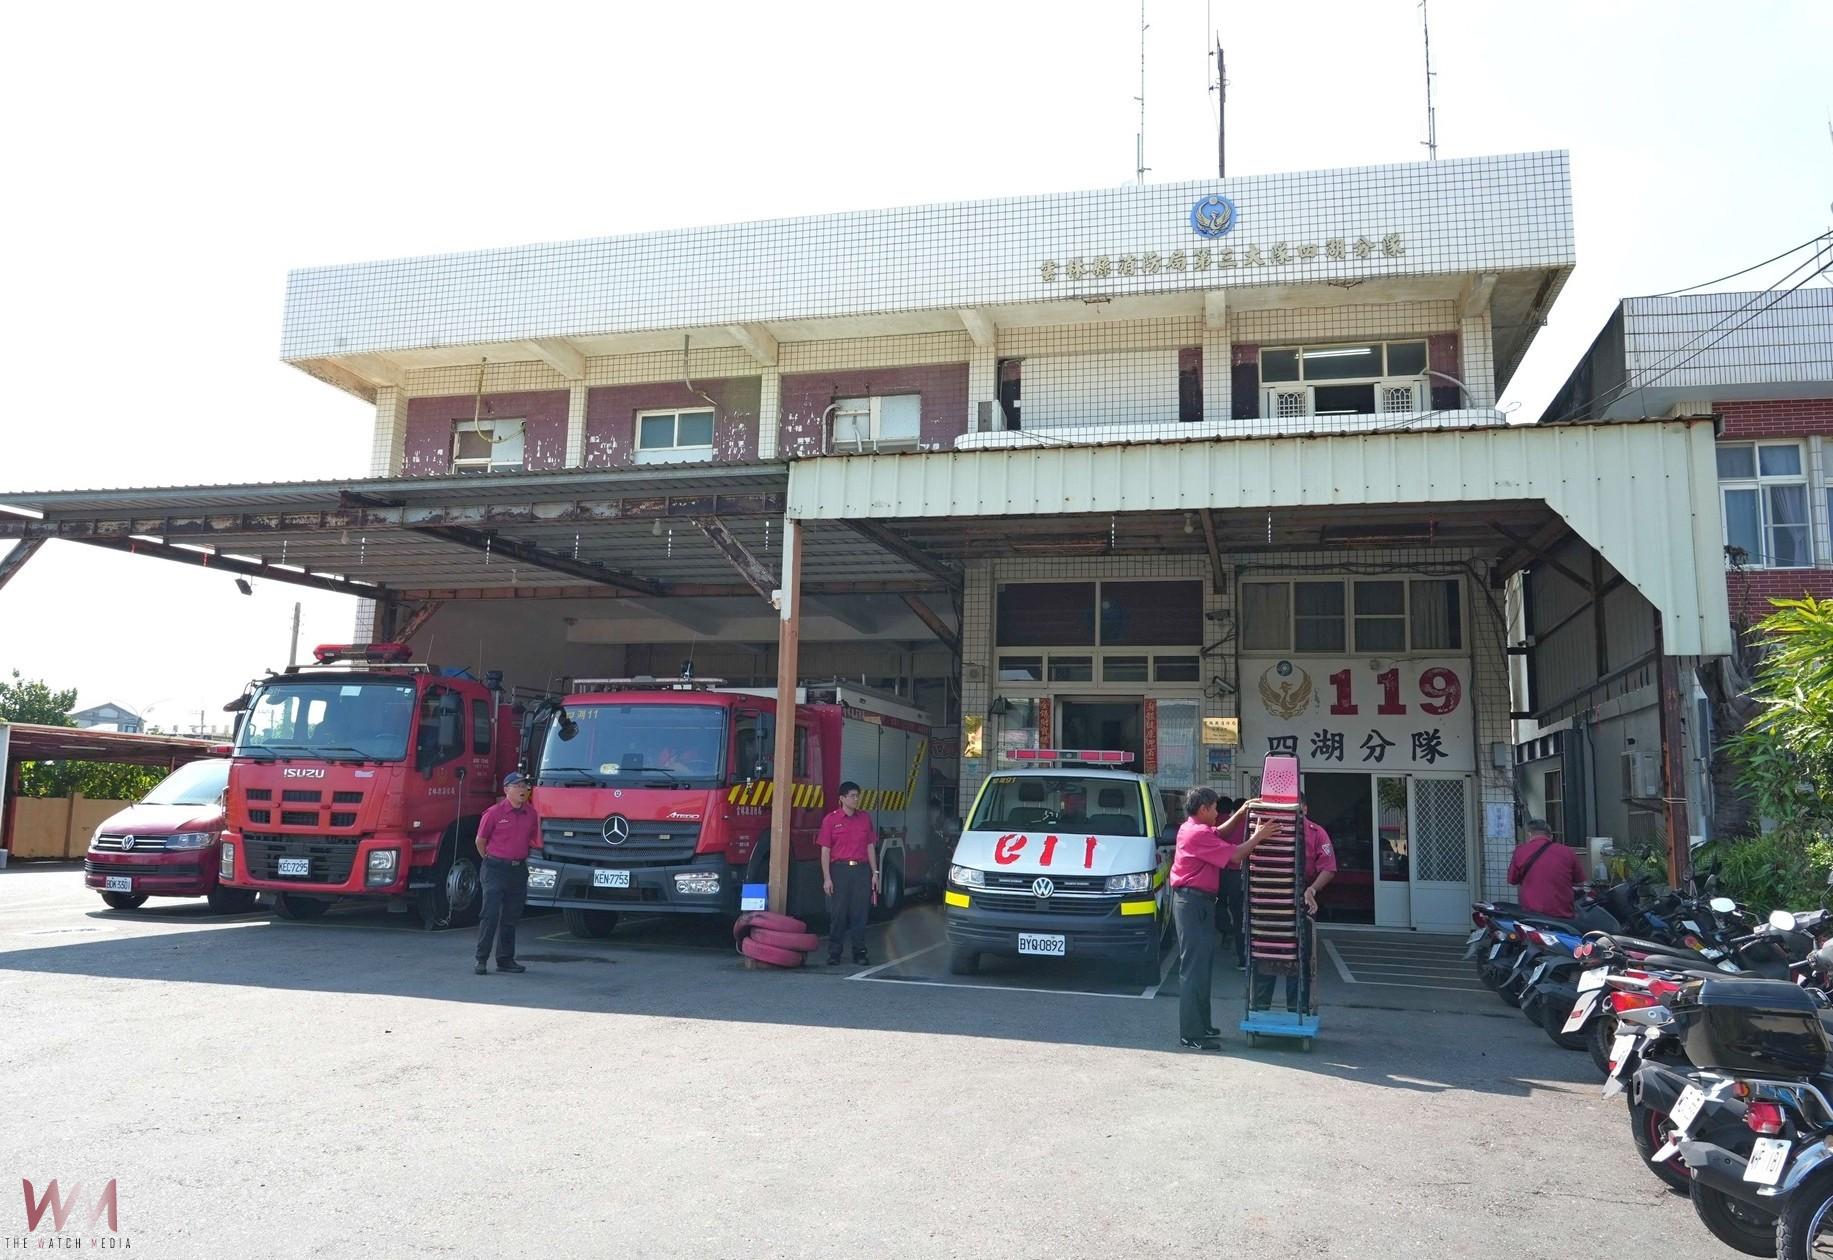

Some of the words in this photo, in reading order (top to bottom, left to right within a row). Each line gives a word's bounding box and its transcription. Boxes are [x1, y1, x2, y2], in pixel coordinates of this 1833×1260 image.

[1040, 232, 1405, 282] 雲林縣消防局第三大隊四湖分隊
[1329, 667, 1462, 716] 119
[1266, 728, 1449, 765] 四湖分隊
[283, 768, 325, 778] ISUZU
